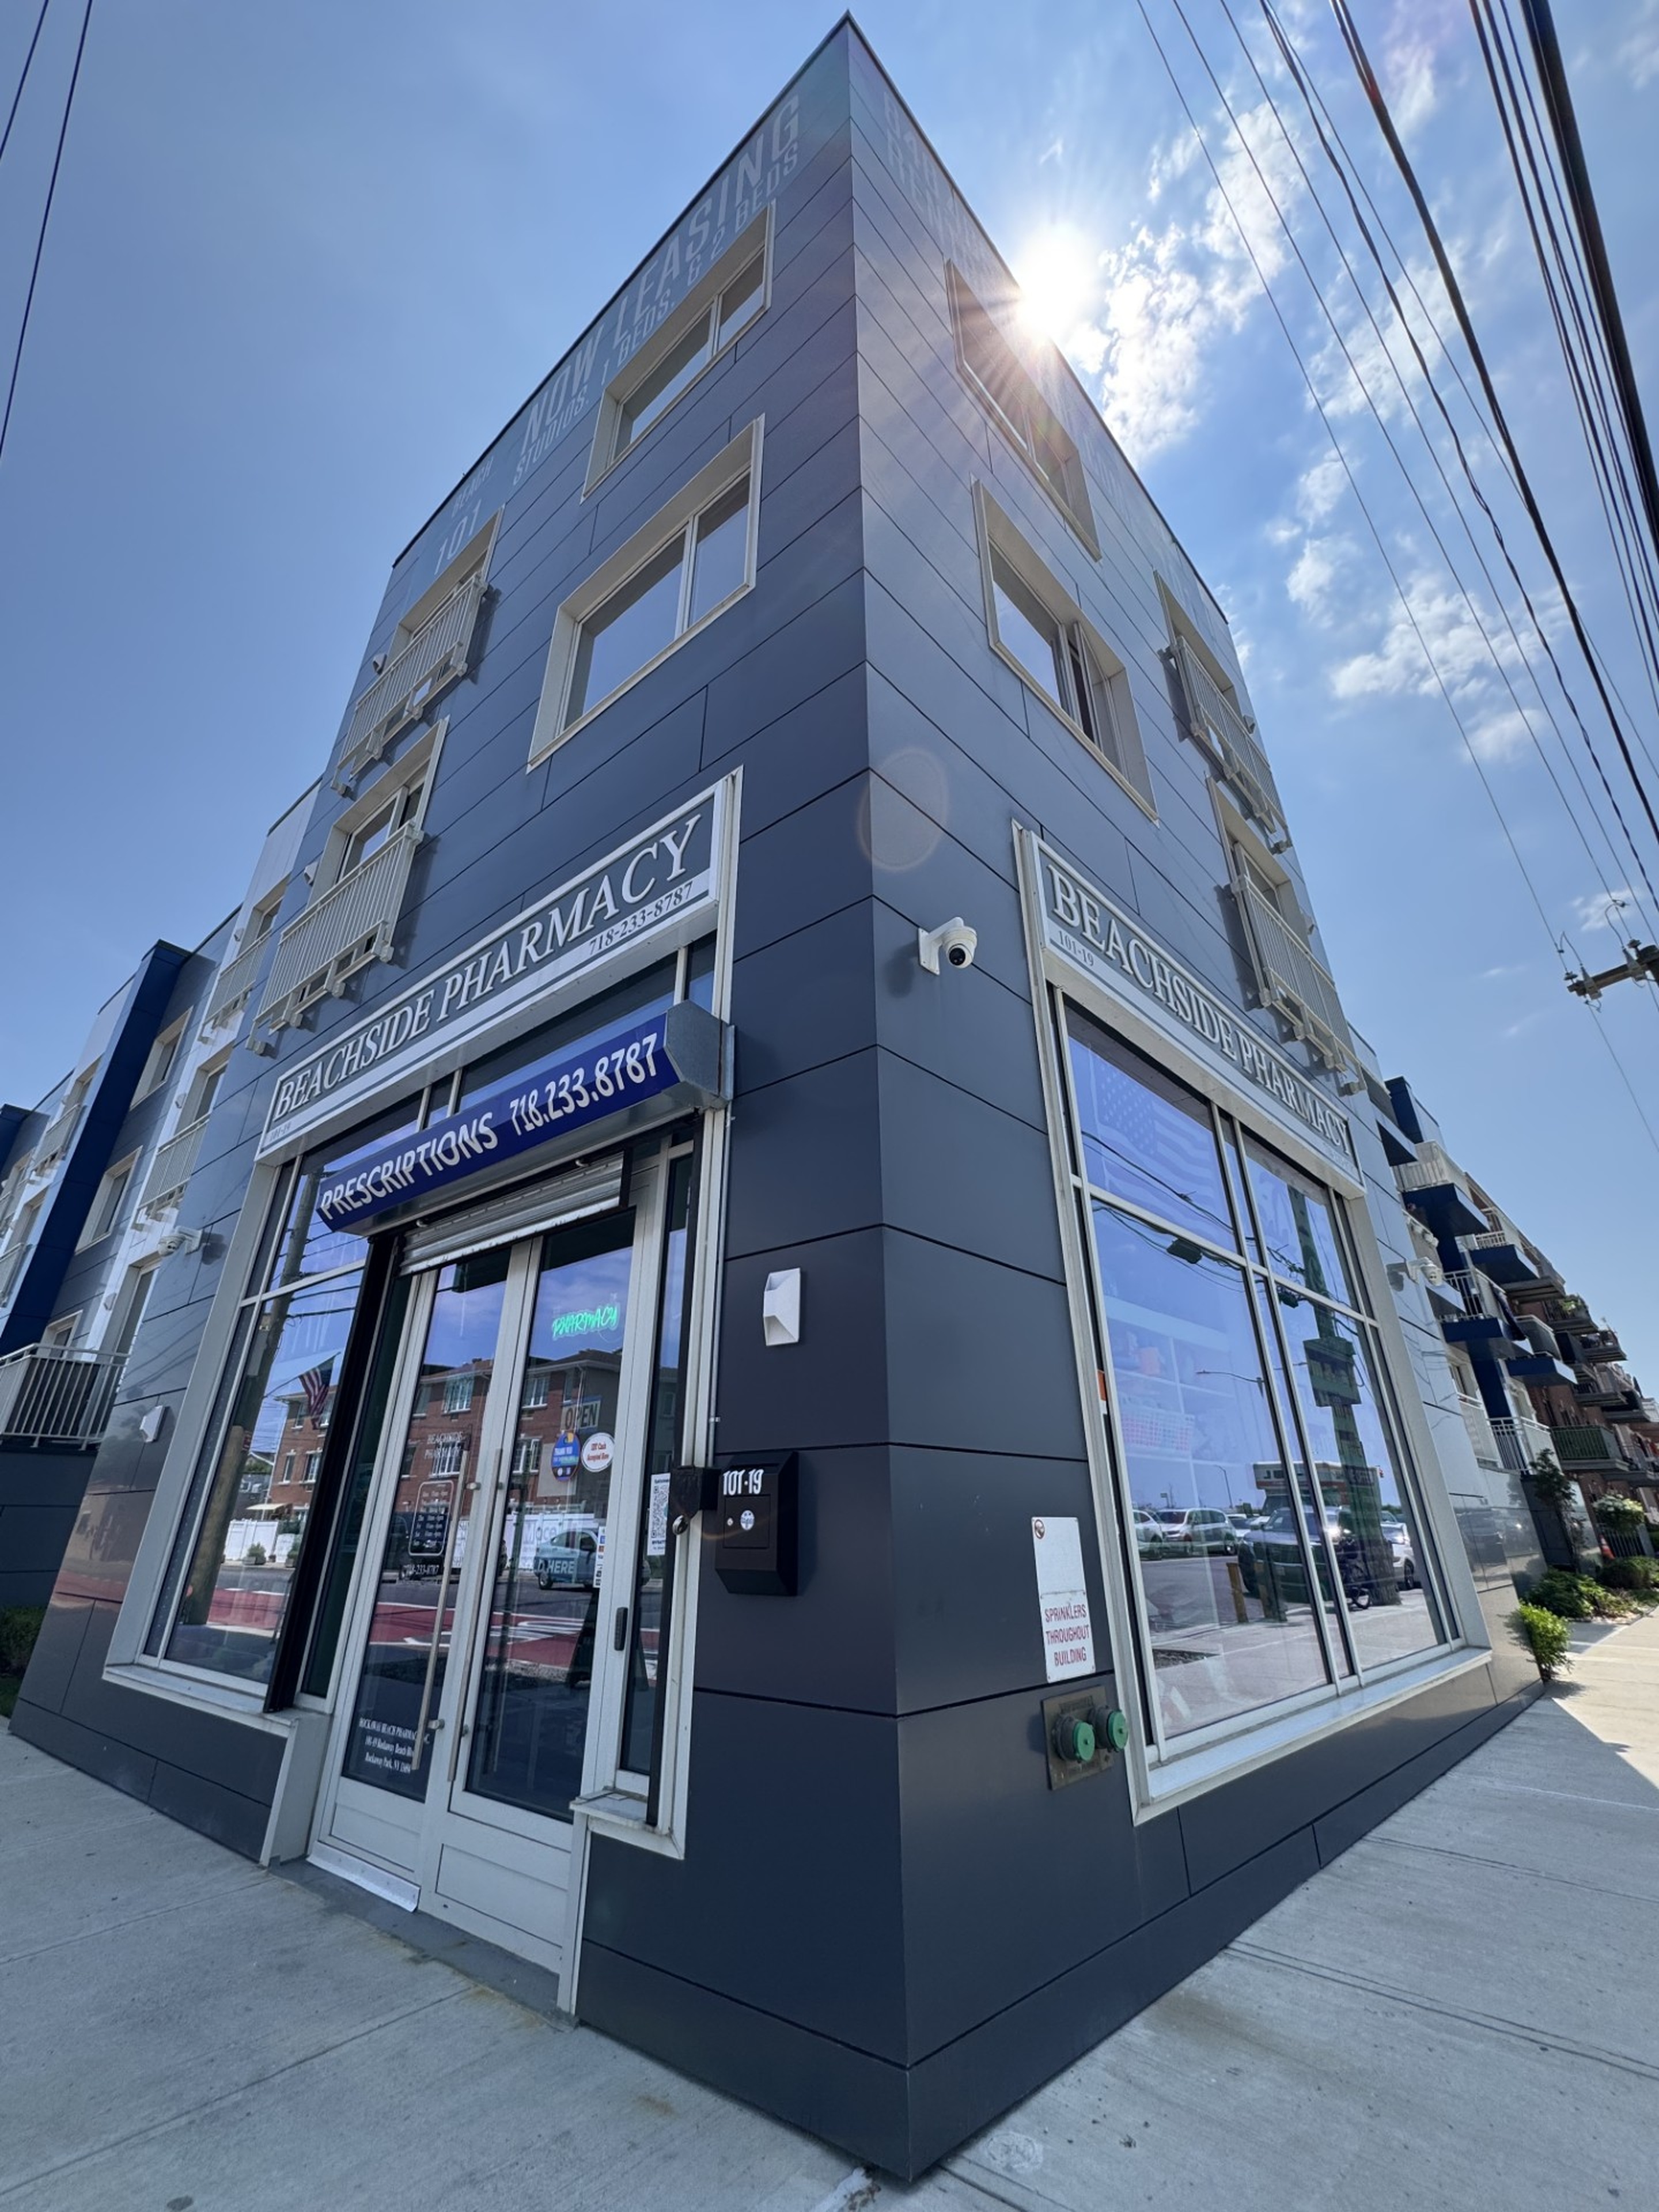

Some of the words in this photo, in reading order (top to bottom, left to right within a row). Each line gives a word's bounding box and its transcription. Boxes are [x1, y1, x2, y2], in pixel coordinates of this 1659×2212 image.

[521, 324, 604, 455] NOW
[613, 94, 799, 350] LEASING
[601, 359, 609, 385] 1
[688, 255, 702, 286] &
[711, 226, 725, 260] 2
[736, 142, 798, 233] BEDS
[434, 499, 482, 575] 101
[588, 882, 695, 956] 718-233-8787
[1057, 930, 1094, 968] 101-19
[274, 987, 435, 1122] BEACHSIDE
[437, 813, 702, 1022] PHARMACY
[1047, 864, 1237, 1062] BEACHSIDE
[1234, 1030, 1351, 1156] PHARMACY
[321, 1112, 499, 1220] PRESCRIPTIONS
[509, 1033, 658, 1137] 718.233.8787
[565, 1403, 598, 1430] OPEN
[547, 1559, 575, 1574] HERE
[1044, 1604, 1086, 1622] SPRINKLERS
[1046, 1624, 1089, 1645] THROUGHOUT
[1054, 1646, 1087, 1666] BUILDING
